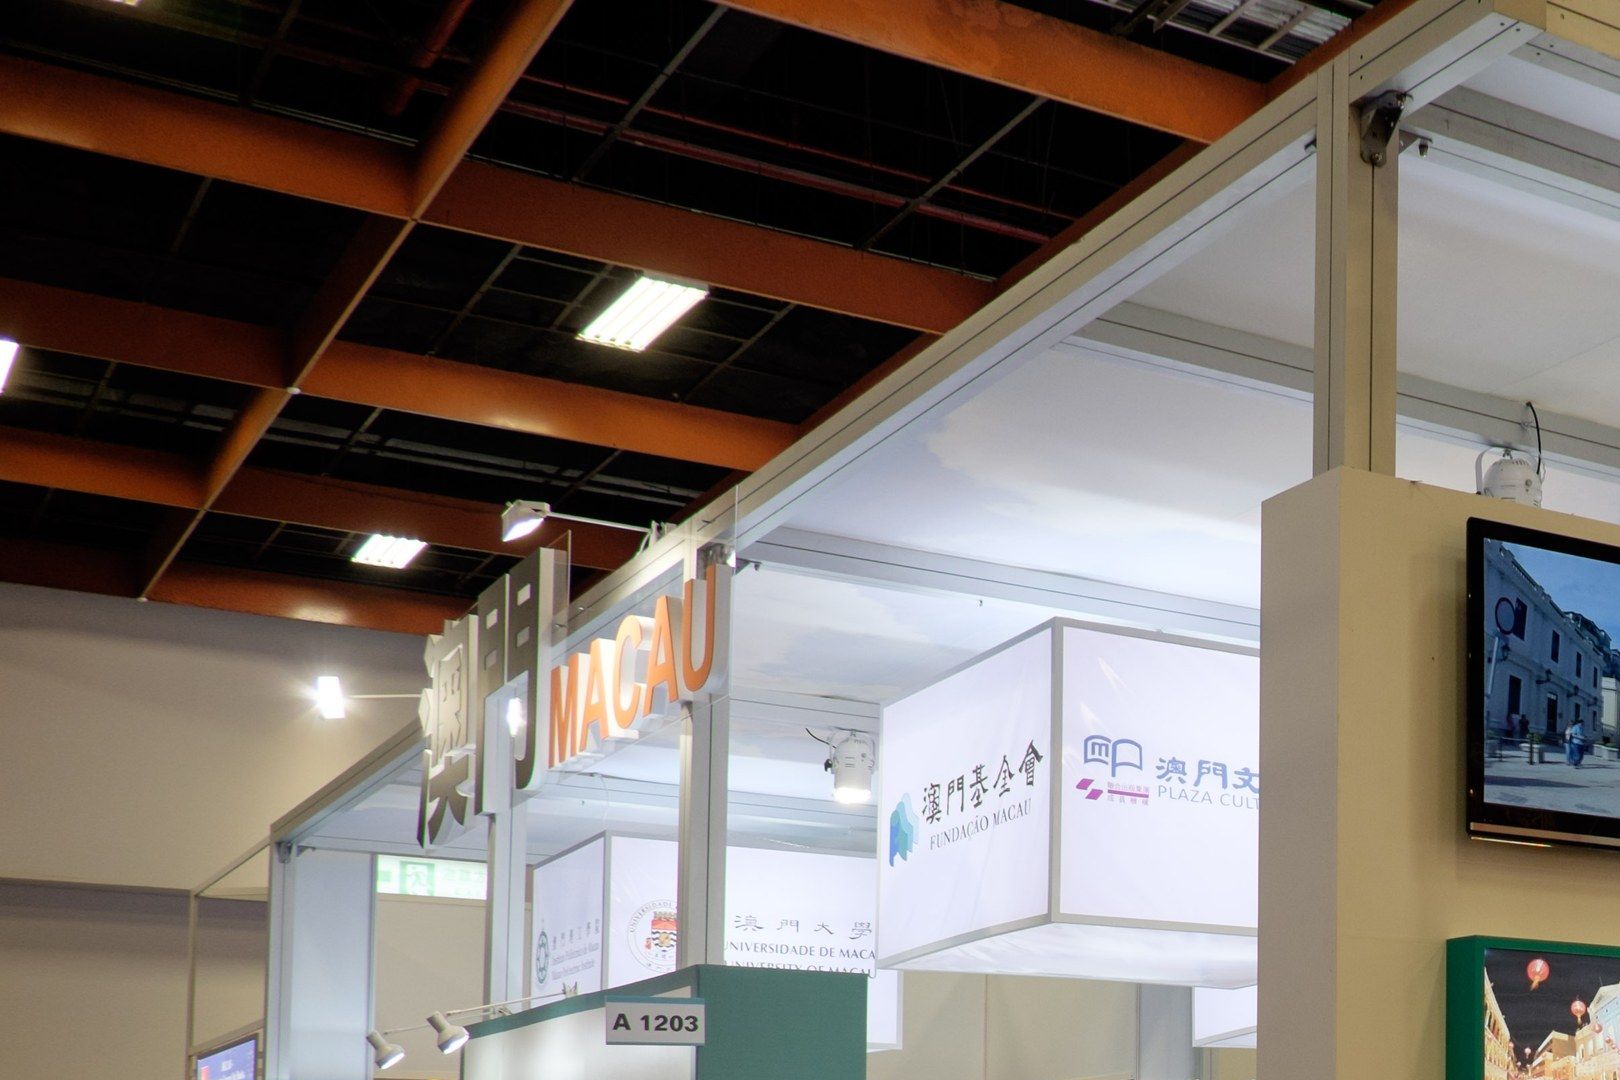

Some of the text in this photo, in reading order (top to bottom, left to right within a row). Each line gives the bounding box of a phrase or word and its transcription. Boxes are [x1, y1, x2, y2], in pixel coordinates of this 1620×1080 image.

[417, 547, 724, 848] 澳門 MACAU
[922, 740, 1043, 824] 澳門基金會
[1158, 784, 1213, 805] PLAZA
[929, 798, 1031, 850] FUNDAÇÃO MACAU
[733, 914, 872, 940] 澳門大學
[819, 944, 835, 958] DE
[612, 1013, 699, 1032] A 1203
